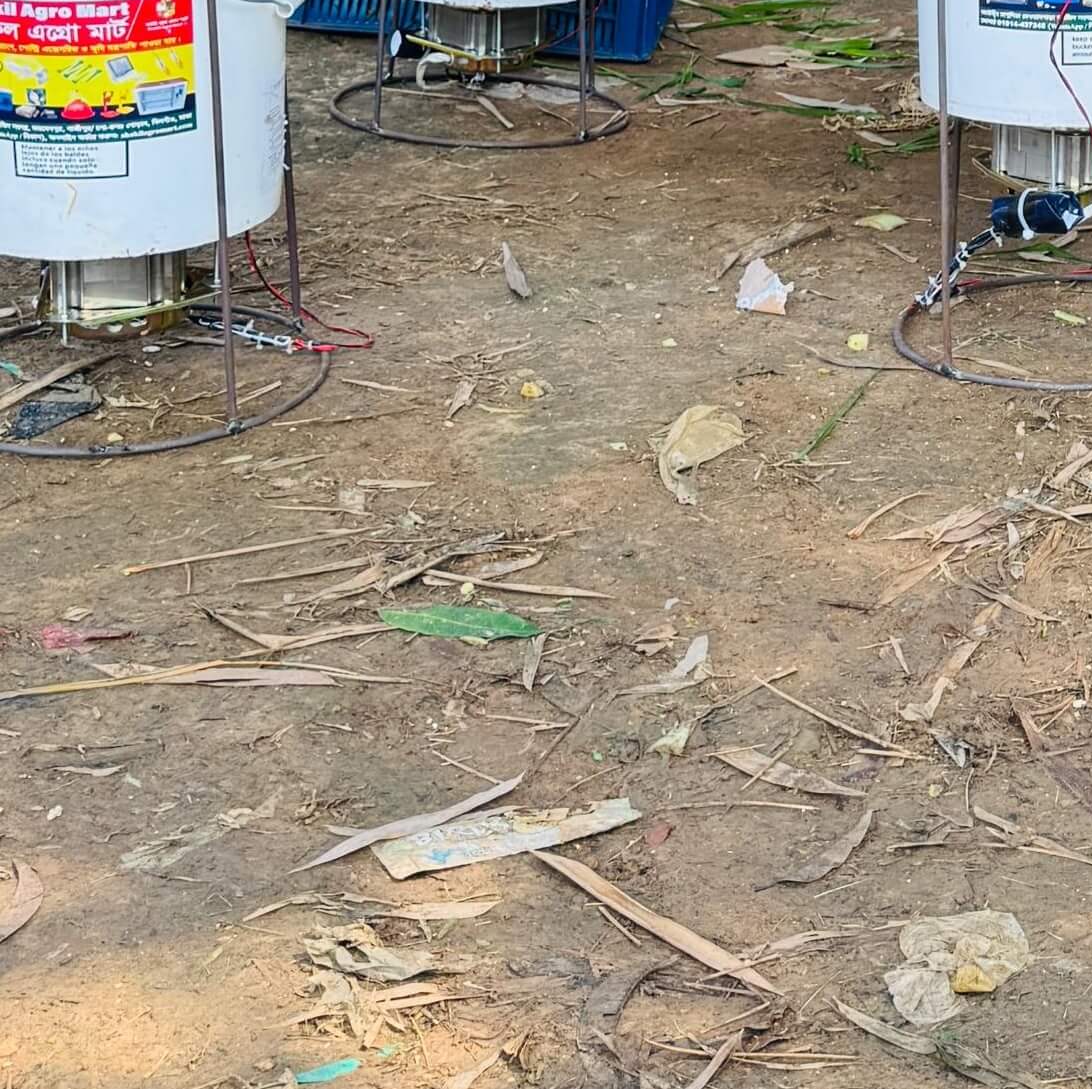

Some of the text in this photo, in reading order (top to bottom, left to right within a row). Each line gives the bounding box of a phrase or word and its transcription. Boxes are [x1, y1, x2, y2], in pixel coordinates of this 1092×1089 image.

[20, 3, 73, 21] Agro
[76, 2, 130, 18] Mart
[27, 22, 82, 43] এগ্রো
[85, 15, 130, 42] মার্ট
